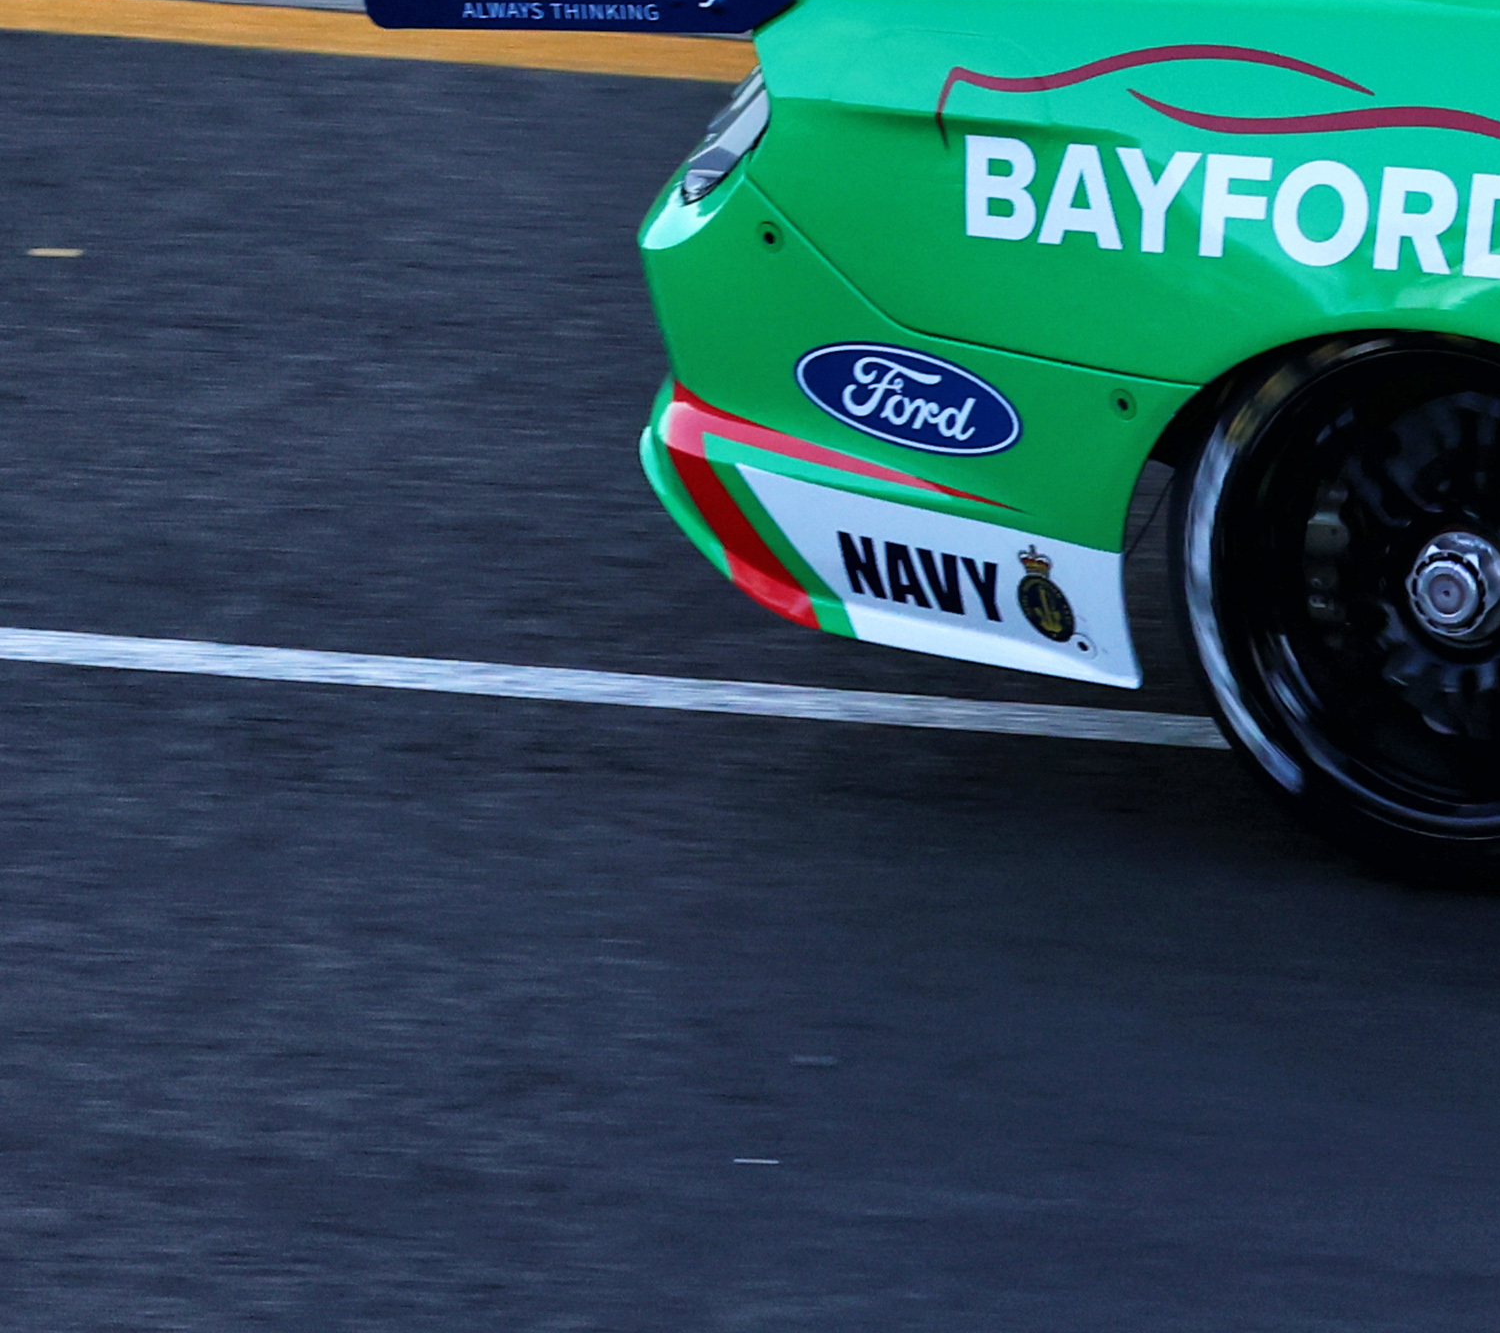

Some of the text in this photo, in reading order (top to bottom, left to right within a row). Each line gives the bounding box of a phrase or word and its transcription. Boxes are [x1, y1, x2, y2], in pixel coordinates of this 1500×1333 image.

[463, 2, 659, 22] ALWAYS THINKING
[841, 355, 976, 441] Ford
[836, 531, 1002, 623] NAVY
